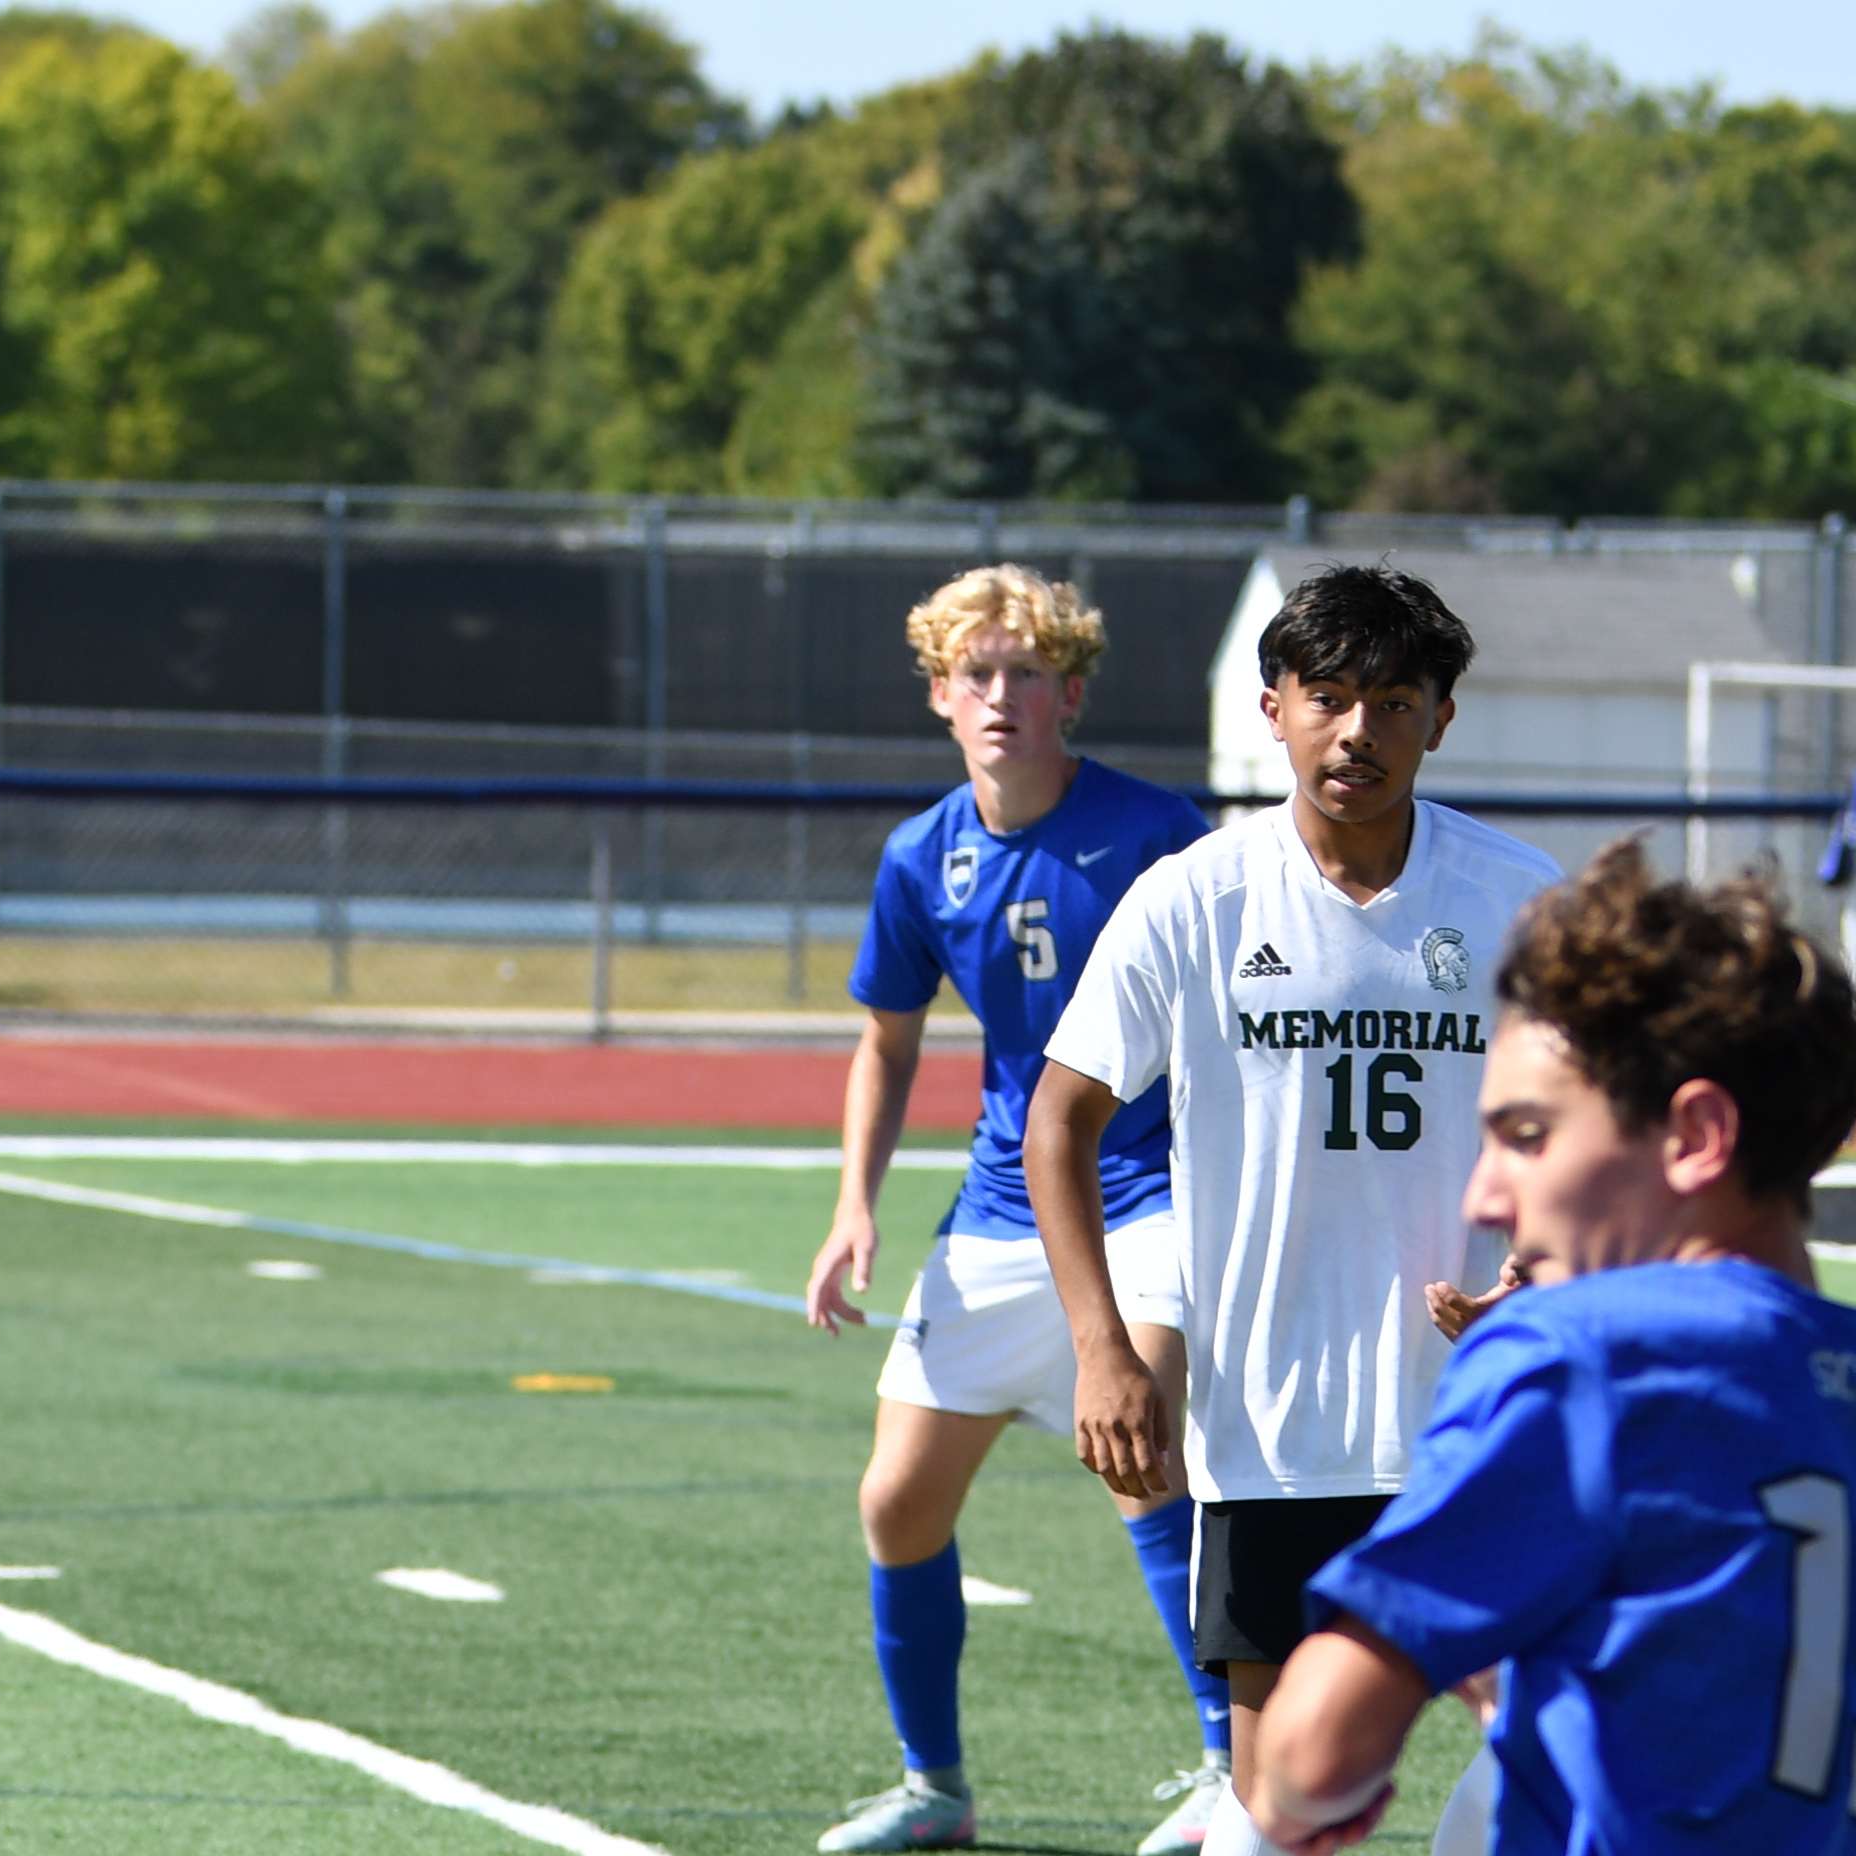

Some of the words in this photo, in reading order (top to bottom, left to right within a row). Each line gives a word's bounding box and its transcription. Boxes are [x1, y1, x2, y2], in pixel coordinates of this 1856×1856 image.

[1005, 898, 1059, 982] 5
[1239, 964, 1292, 979] adidas
[1238, 1009, 1487, 1055] MEMORIAL
[1324, 1052, 1423, 1151] 16
